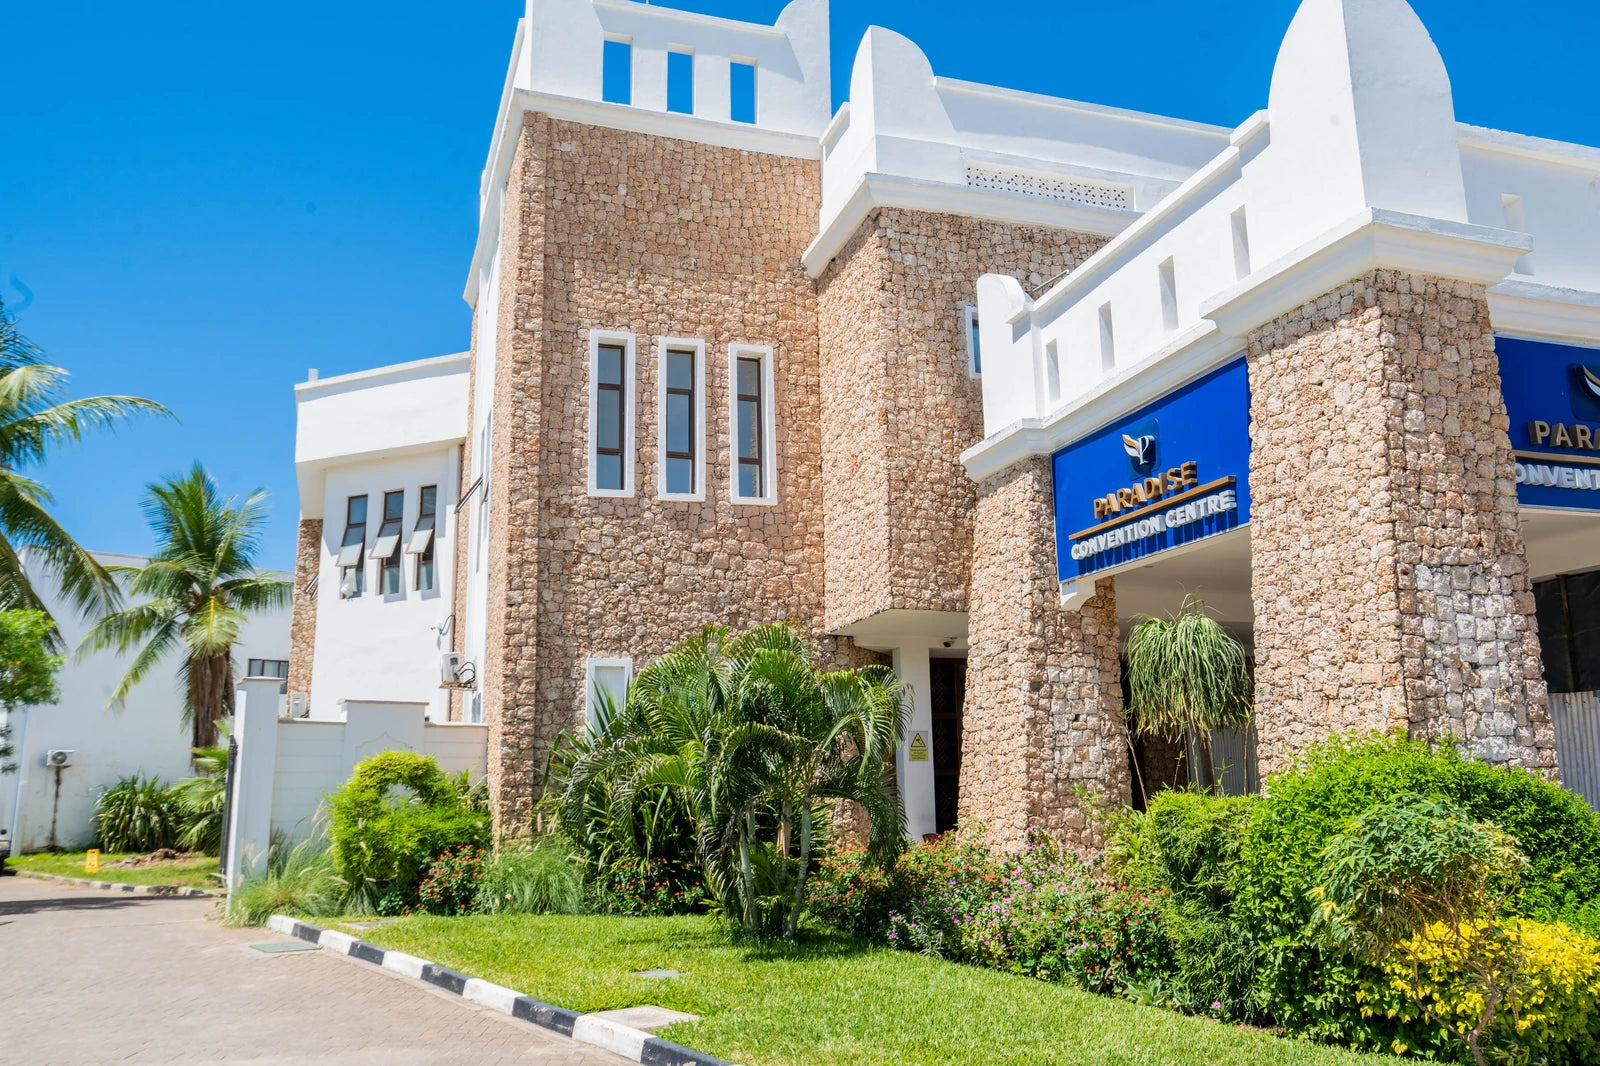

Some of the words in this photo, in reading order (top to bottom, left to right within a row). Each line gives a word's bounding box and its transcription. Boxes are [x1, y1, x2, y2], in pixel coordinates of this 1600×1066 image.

[1528, 420, 1600, 450] PAR
[1093, 461, 1198, 519] PARADISE
[1514, 463, 1600, 490] ONVENT
[1071, 514, 1166, 560] CONVENTION
[1165, 489, 1237, 528] CENTRE
